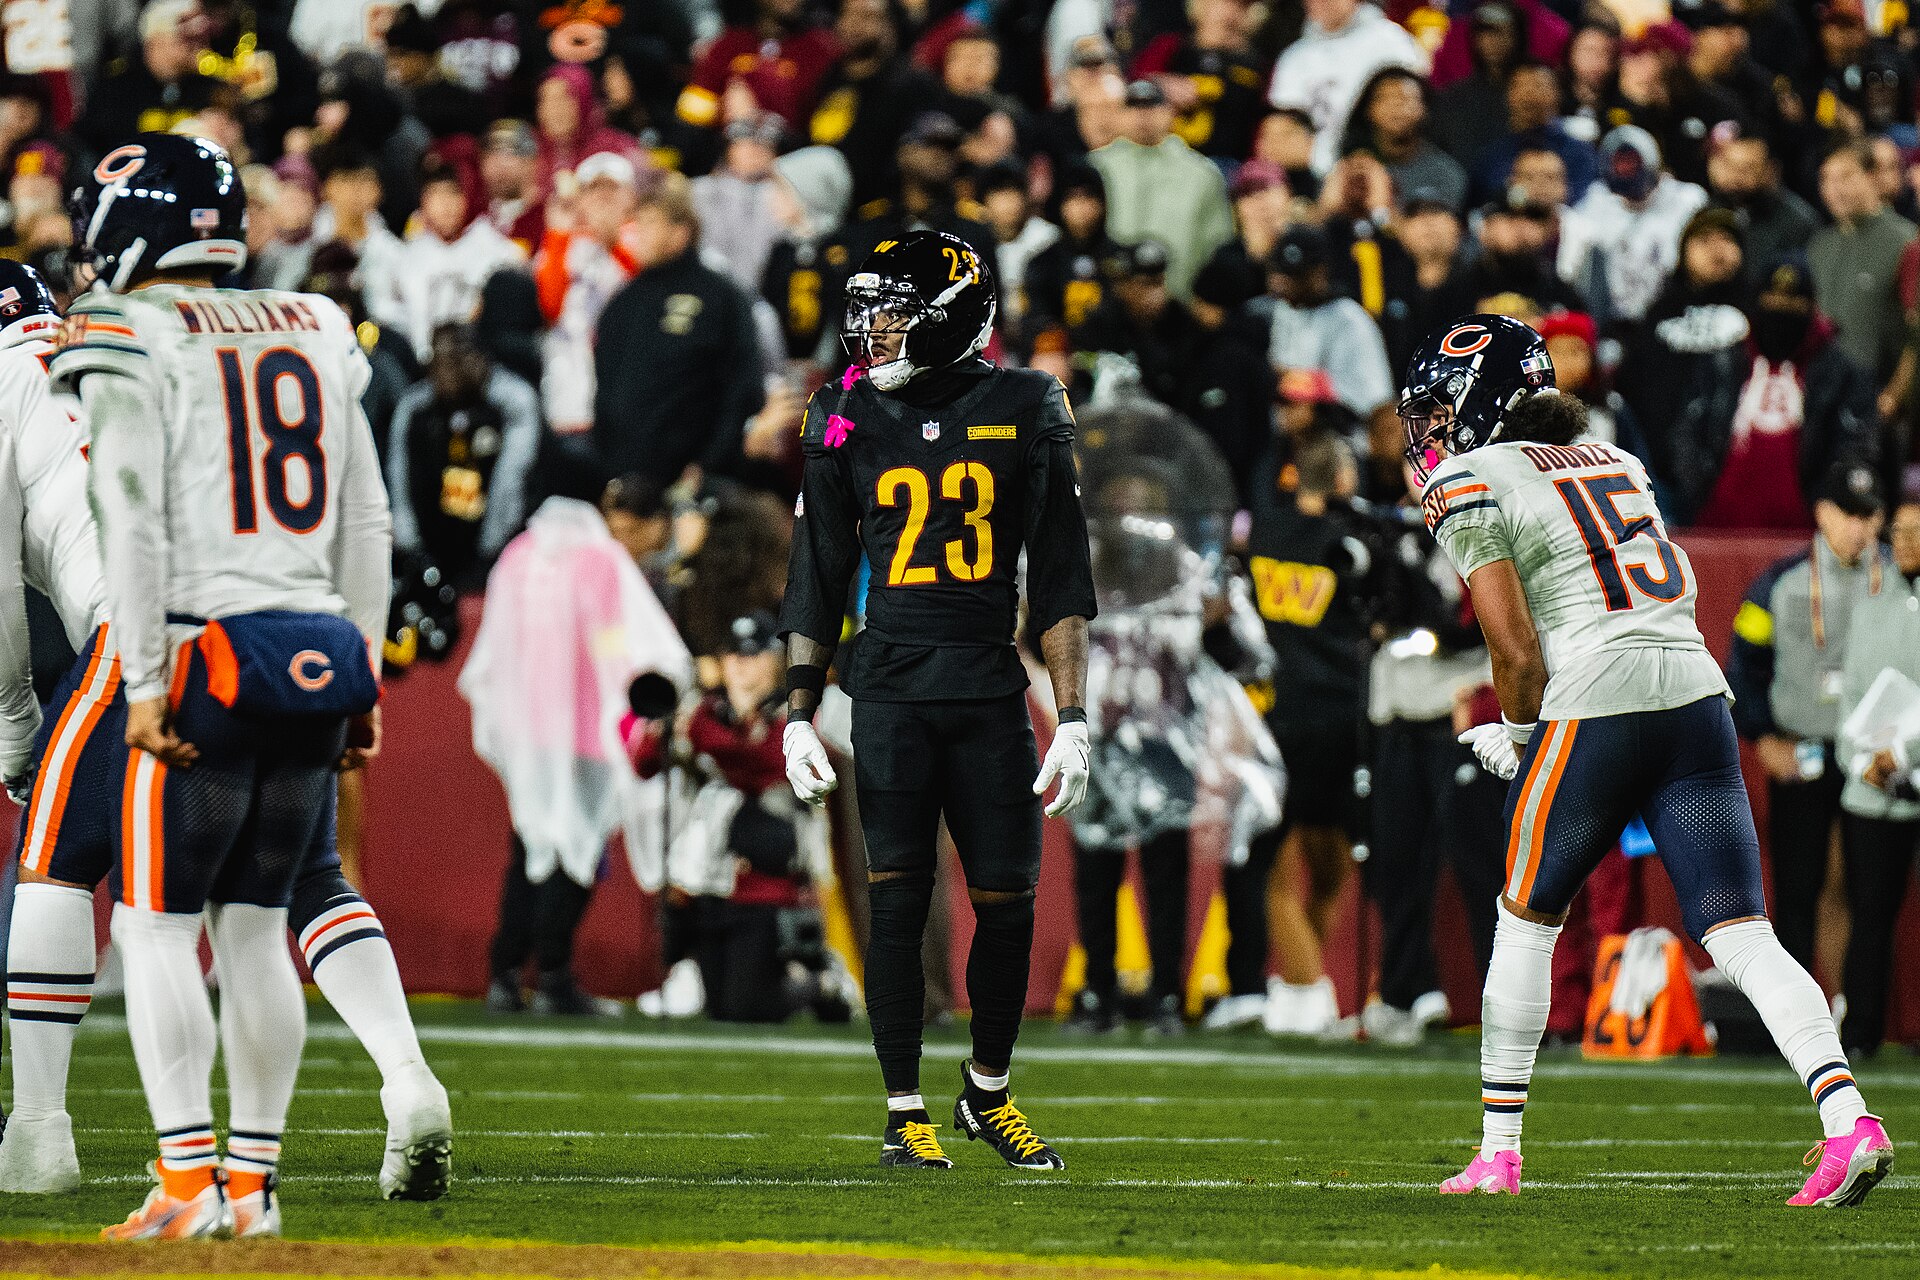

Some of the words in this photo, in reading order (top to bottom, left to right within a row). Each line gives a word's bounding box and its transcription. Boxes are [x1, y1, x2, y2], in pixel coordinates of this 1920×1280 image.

[175, 300, 321, 334] WILLIAMS
[214, 345, 330, 536] 18
[967, 427, 1017, 438] COMMANDERS
[1520, 444, 1623, 473] ODUNZE
[875, 460, 996, 587] 23
[1552, 472, 1687, 612] 15
[960, 1099, 981, 1133] NIKE
